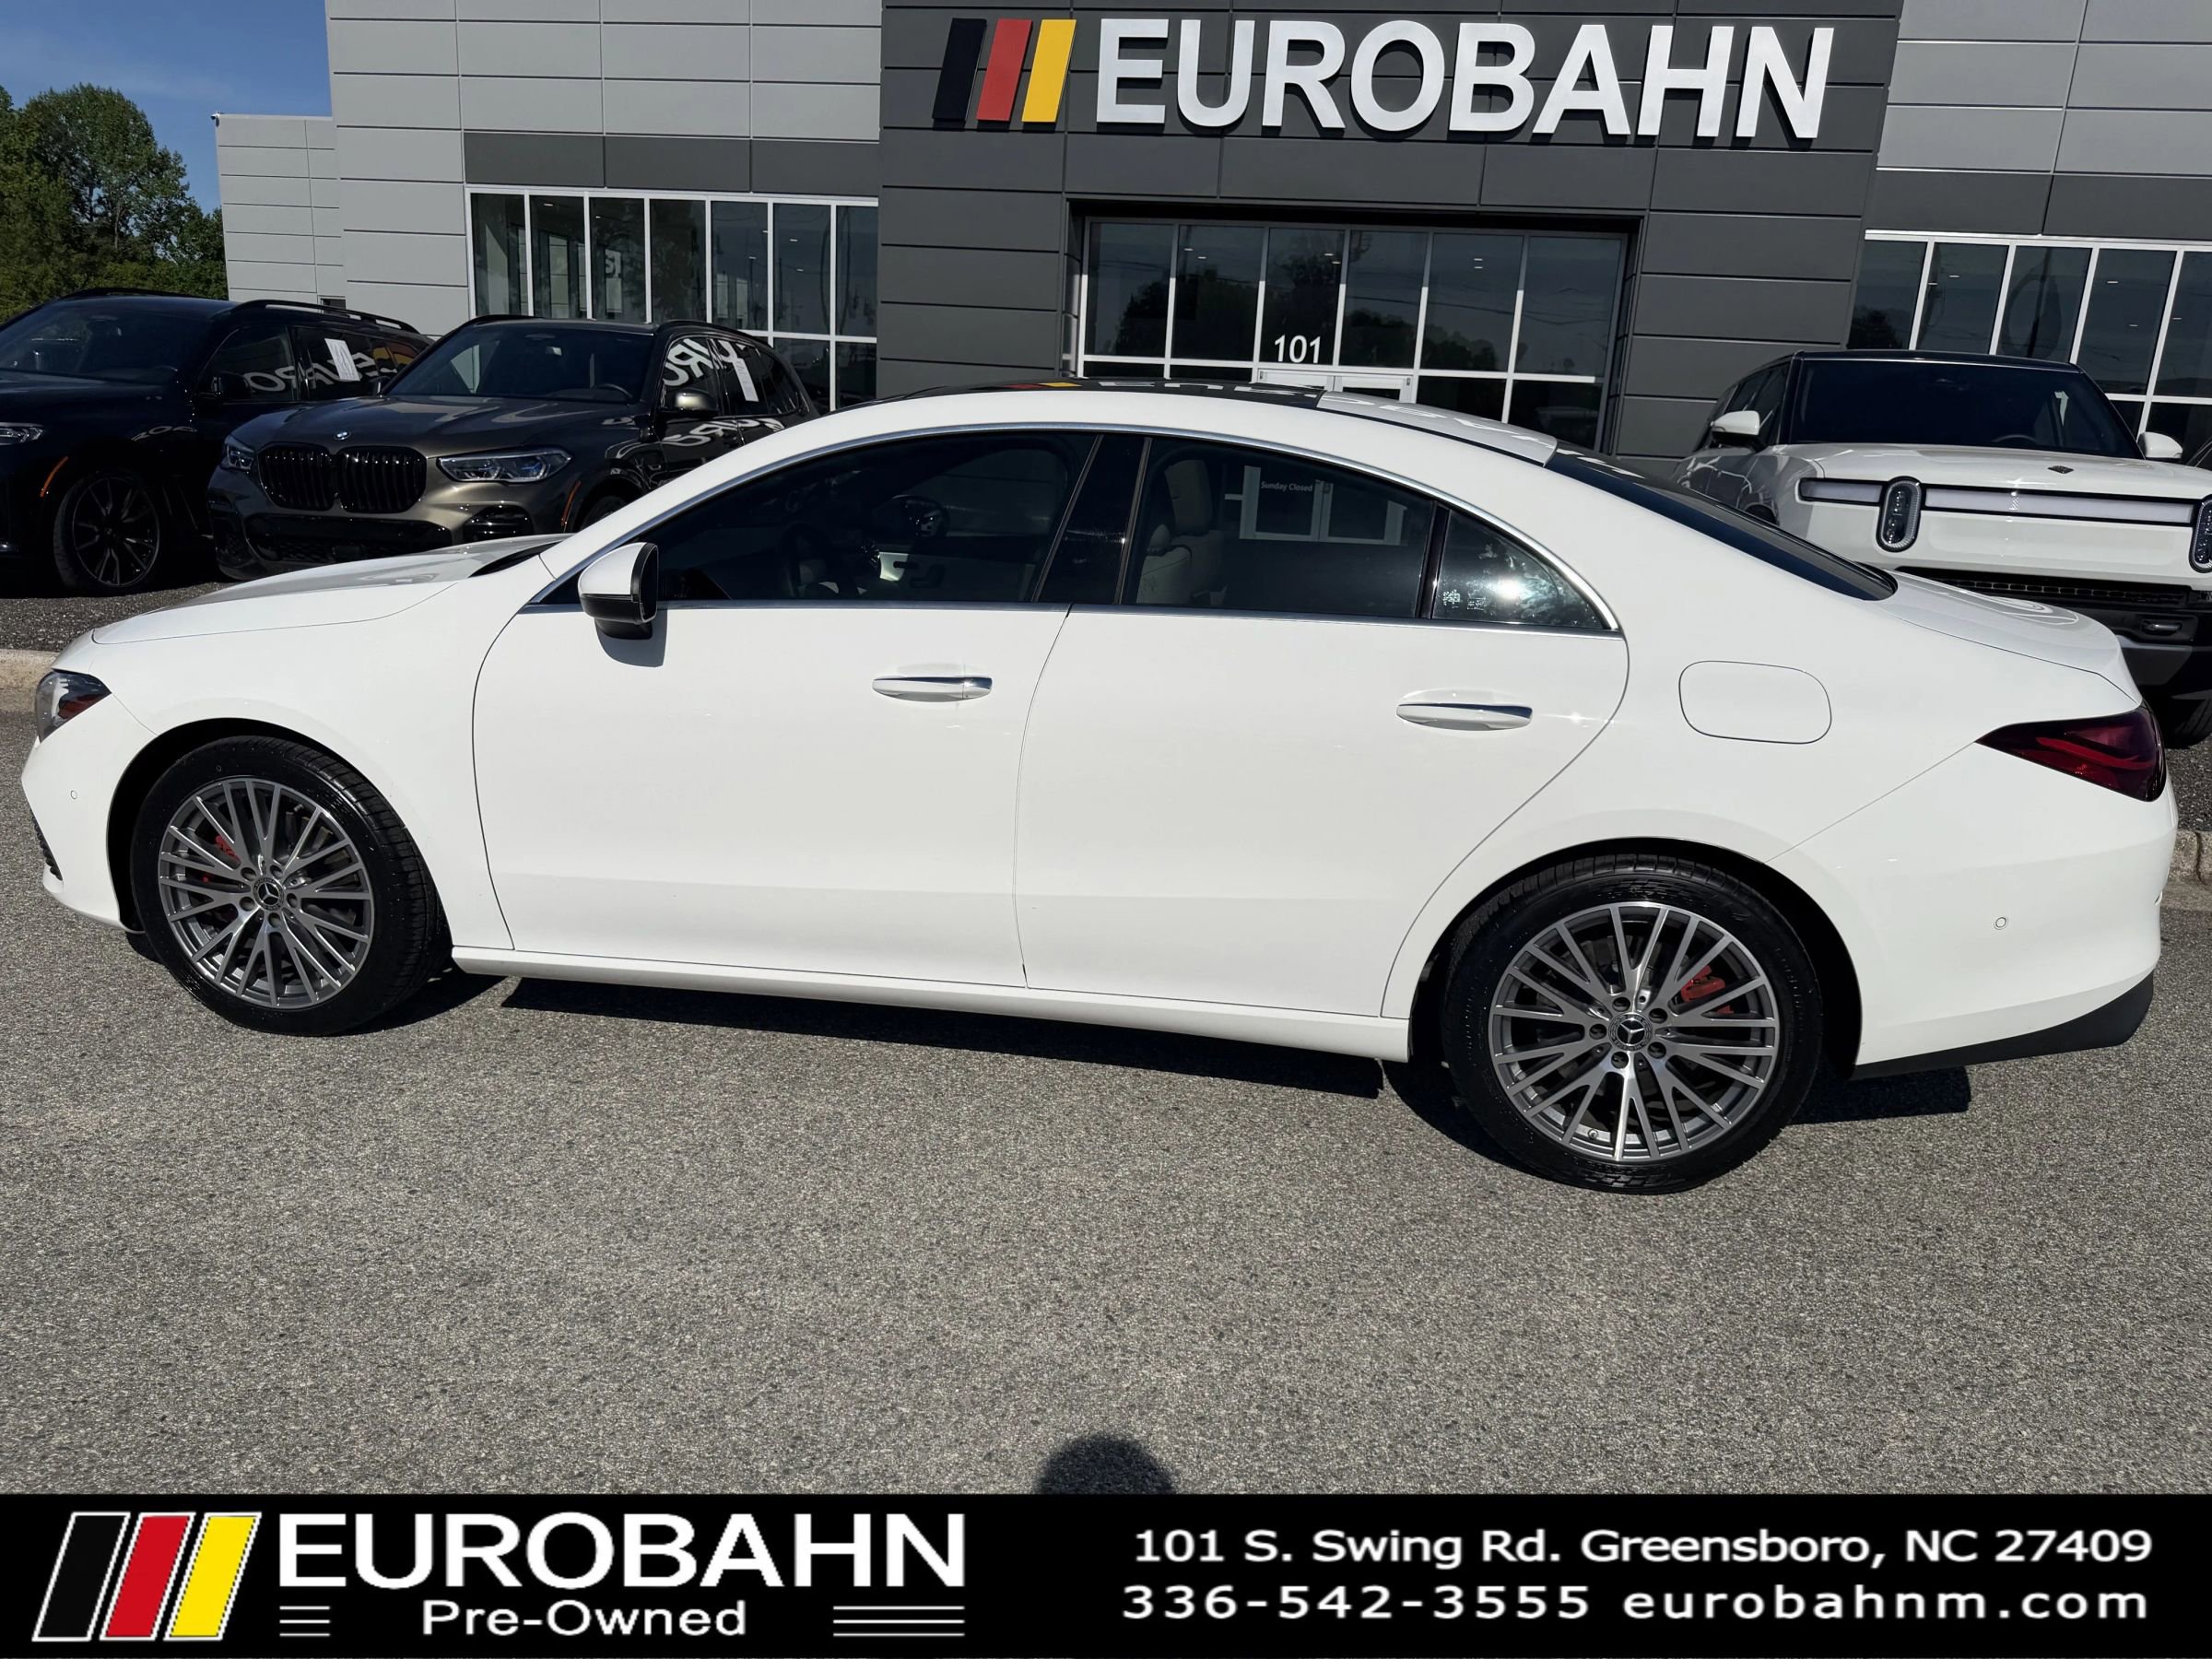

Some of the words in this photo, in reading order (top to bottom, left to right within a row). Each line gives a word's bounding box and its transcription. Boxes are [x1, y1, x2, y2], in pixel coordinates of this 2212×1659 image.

[1096, 17, 1835, 139] EUROBAHN
[1274, 334, 1322, 365] 101
[1260, 480, 1288, 492] Sunday
[1288, 483, 1313, 492] Closed
